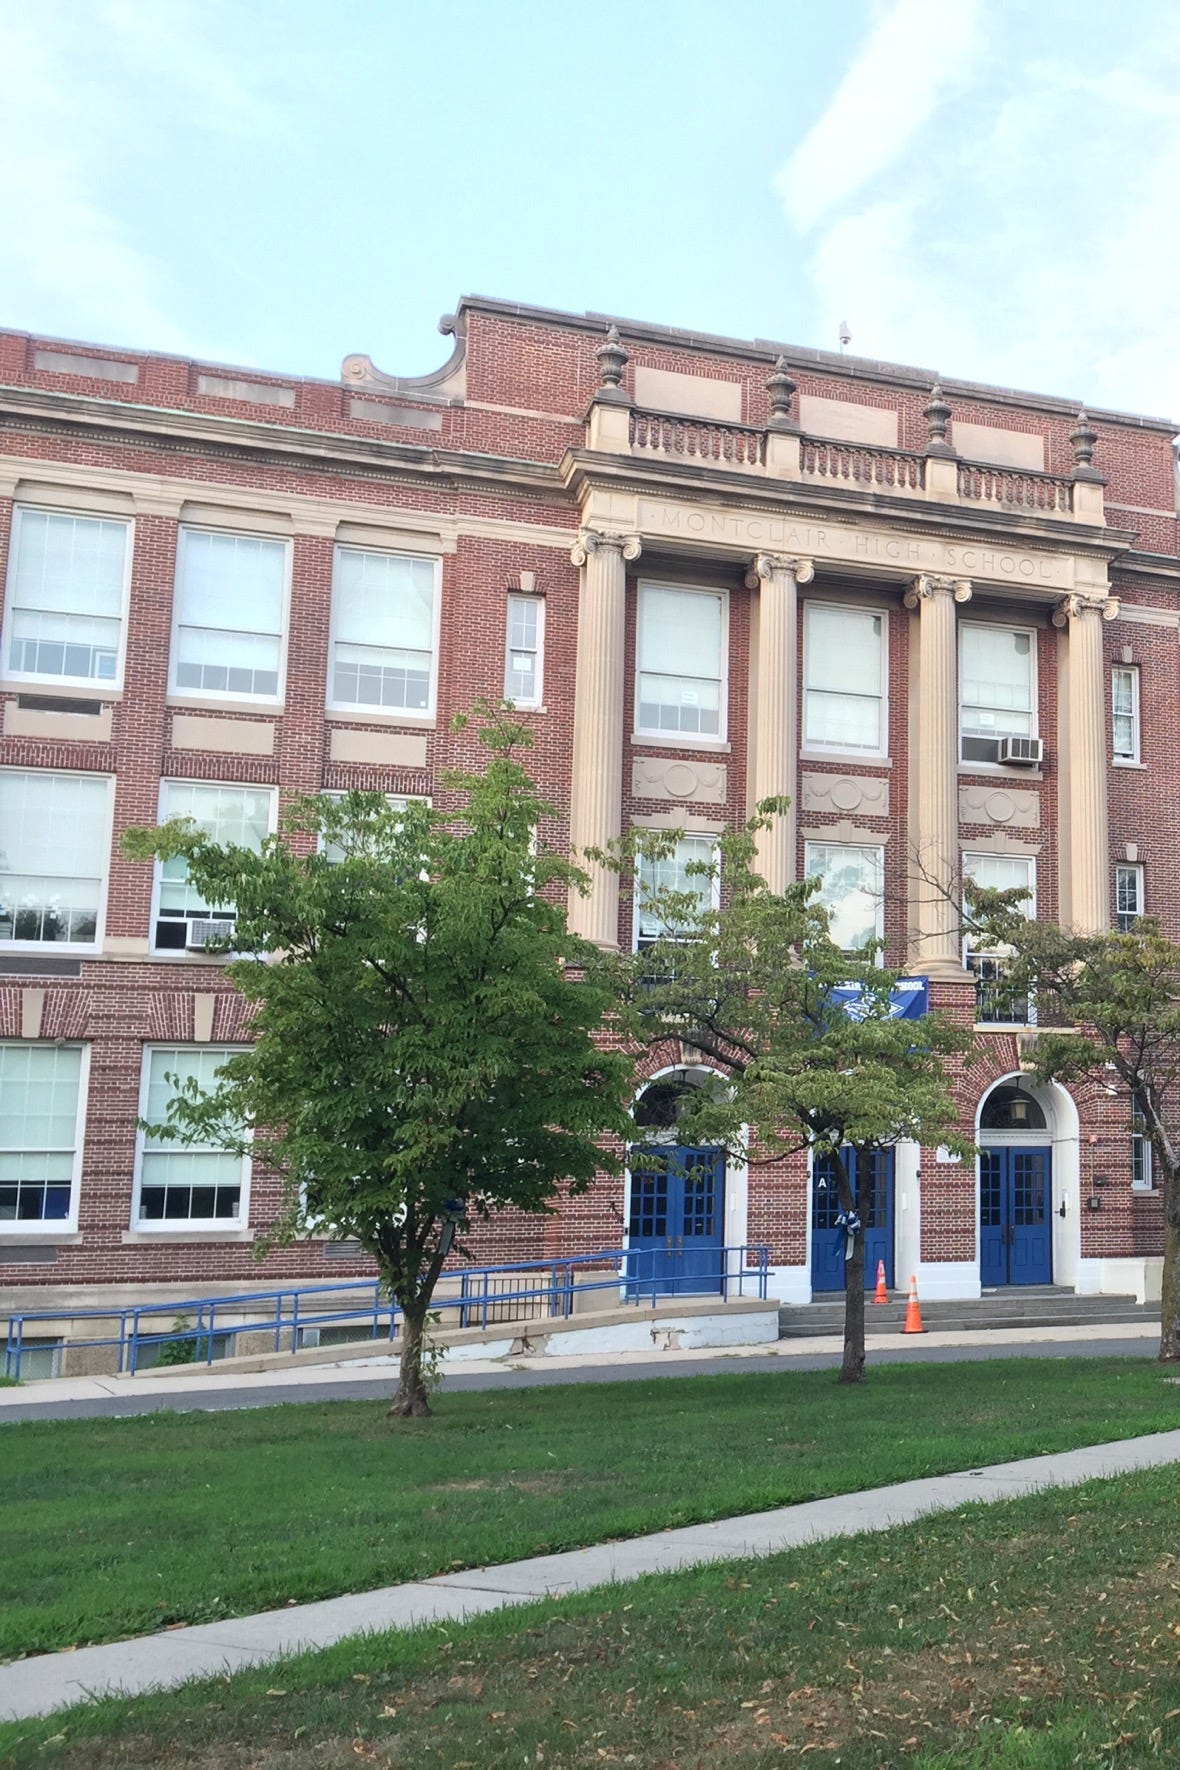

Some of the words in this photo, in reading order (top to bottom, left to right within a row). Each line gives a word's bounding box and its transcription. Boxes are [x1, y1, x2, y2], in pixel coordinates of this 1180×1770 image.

[662, 509, 831, 549] MONTCLAIR
[855, 535, 921, 561] HIGH
[946, 549, 1052, 578] SCHOOL
[818, 1178, 827, 1188] A
